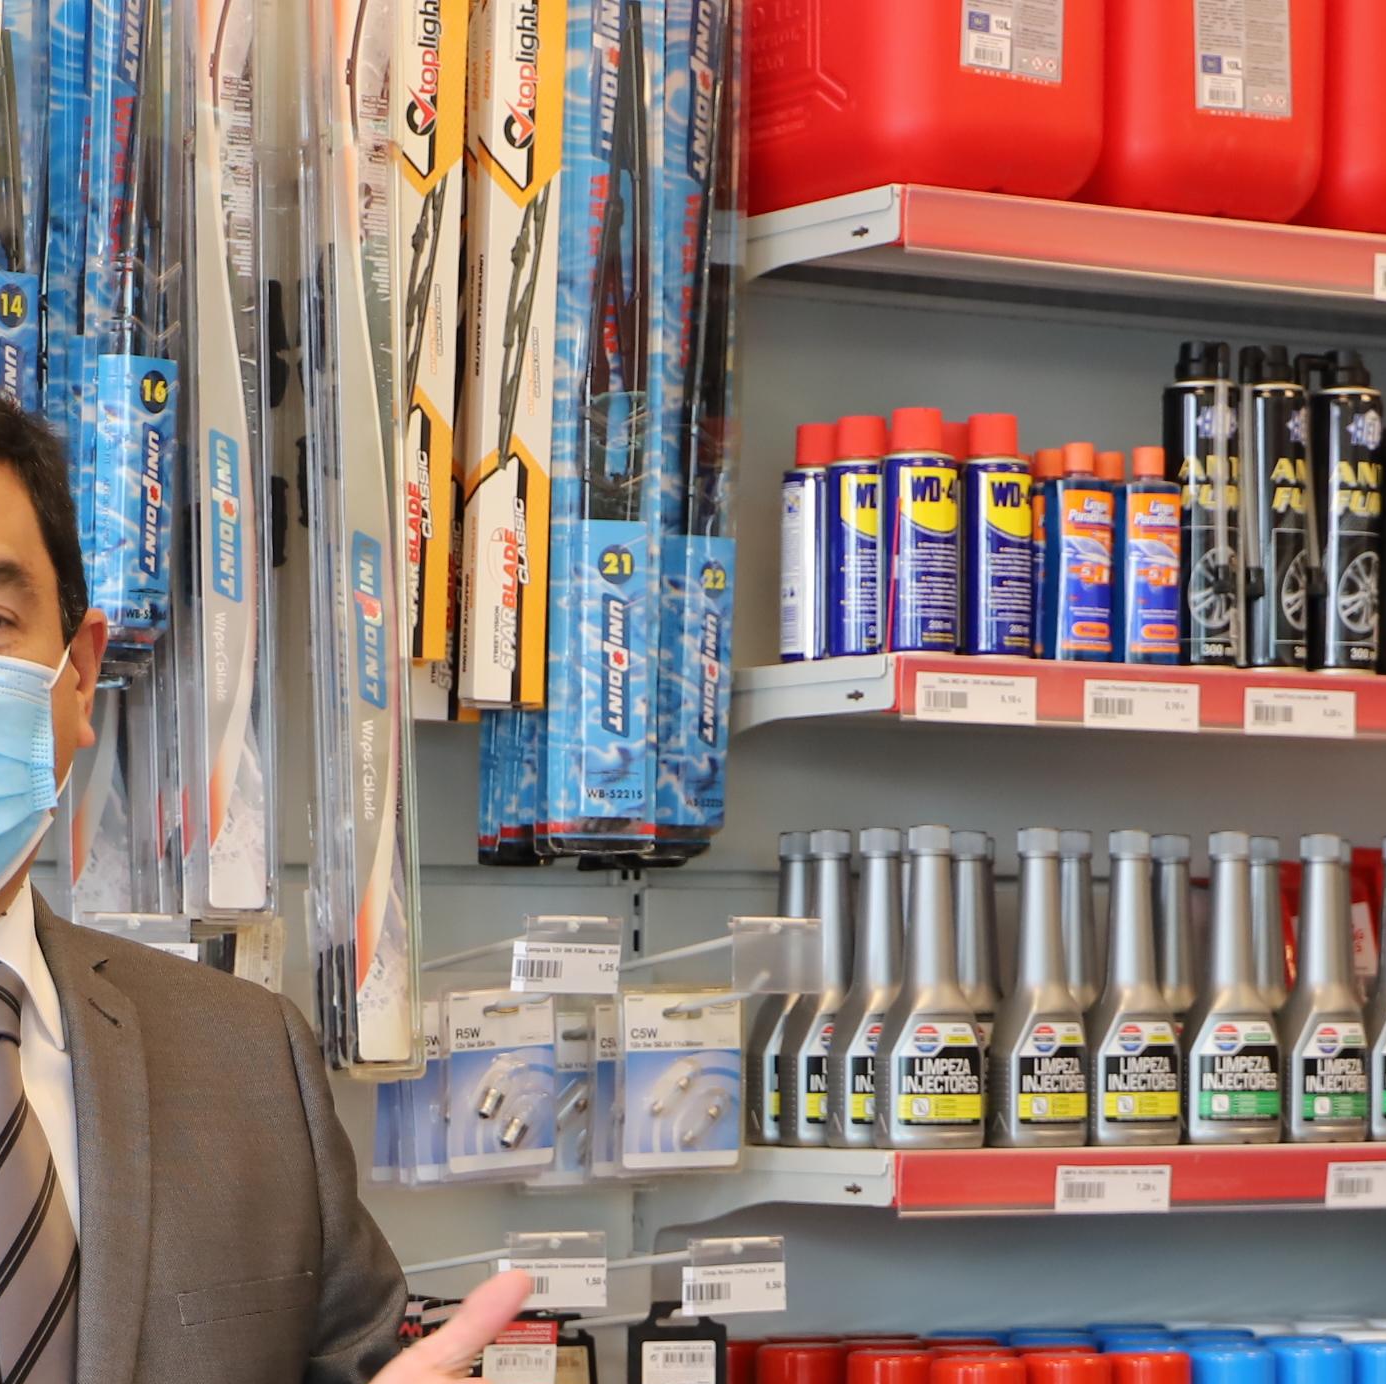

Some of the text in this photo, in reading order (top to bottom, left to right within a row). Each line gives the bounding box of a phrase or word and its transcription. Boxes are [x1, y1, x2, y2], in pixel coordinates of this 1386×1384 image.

[0, 293, 22, 317] 14
[141, 380, 166, 403] 16
[421, 450, 432, 539] CLASSIC
[519, 498, 530, 585] CLASSIC
[603, 553, 632, 575] 21
[703, 571, 725, 589] 22
[586, 788, 642, 799] WB-52215
[455, 1028, 480, 1039] R5W
[631, 1028, 658, 1038] C5W
[915, 1058, 970, 1075] LIMPEZA
[1034, 1058, 1080, 1074] LIMPEZA
[1120, 1057, 1170, 1073] LIMPEZA
[1215, 1056, 1270, 1072] LIMPEZA
[903, 1075, 978, 1093] INJECTORES
[1023, 1075, 1085, 1093] INJECTORES
[1109, 1074, 1177, 1091] INJECTORES
[1203, 1073, 1277, 1090] INJECTORES
